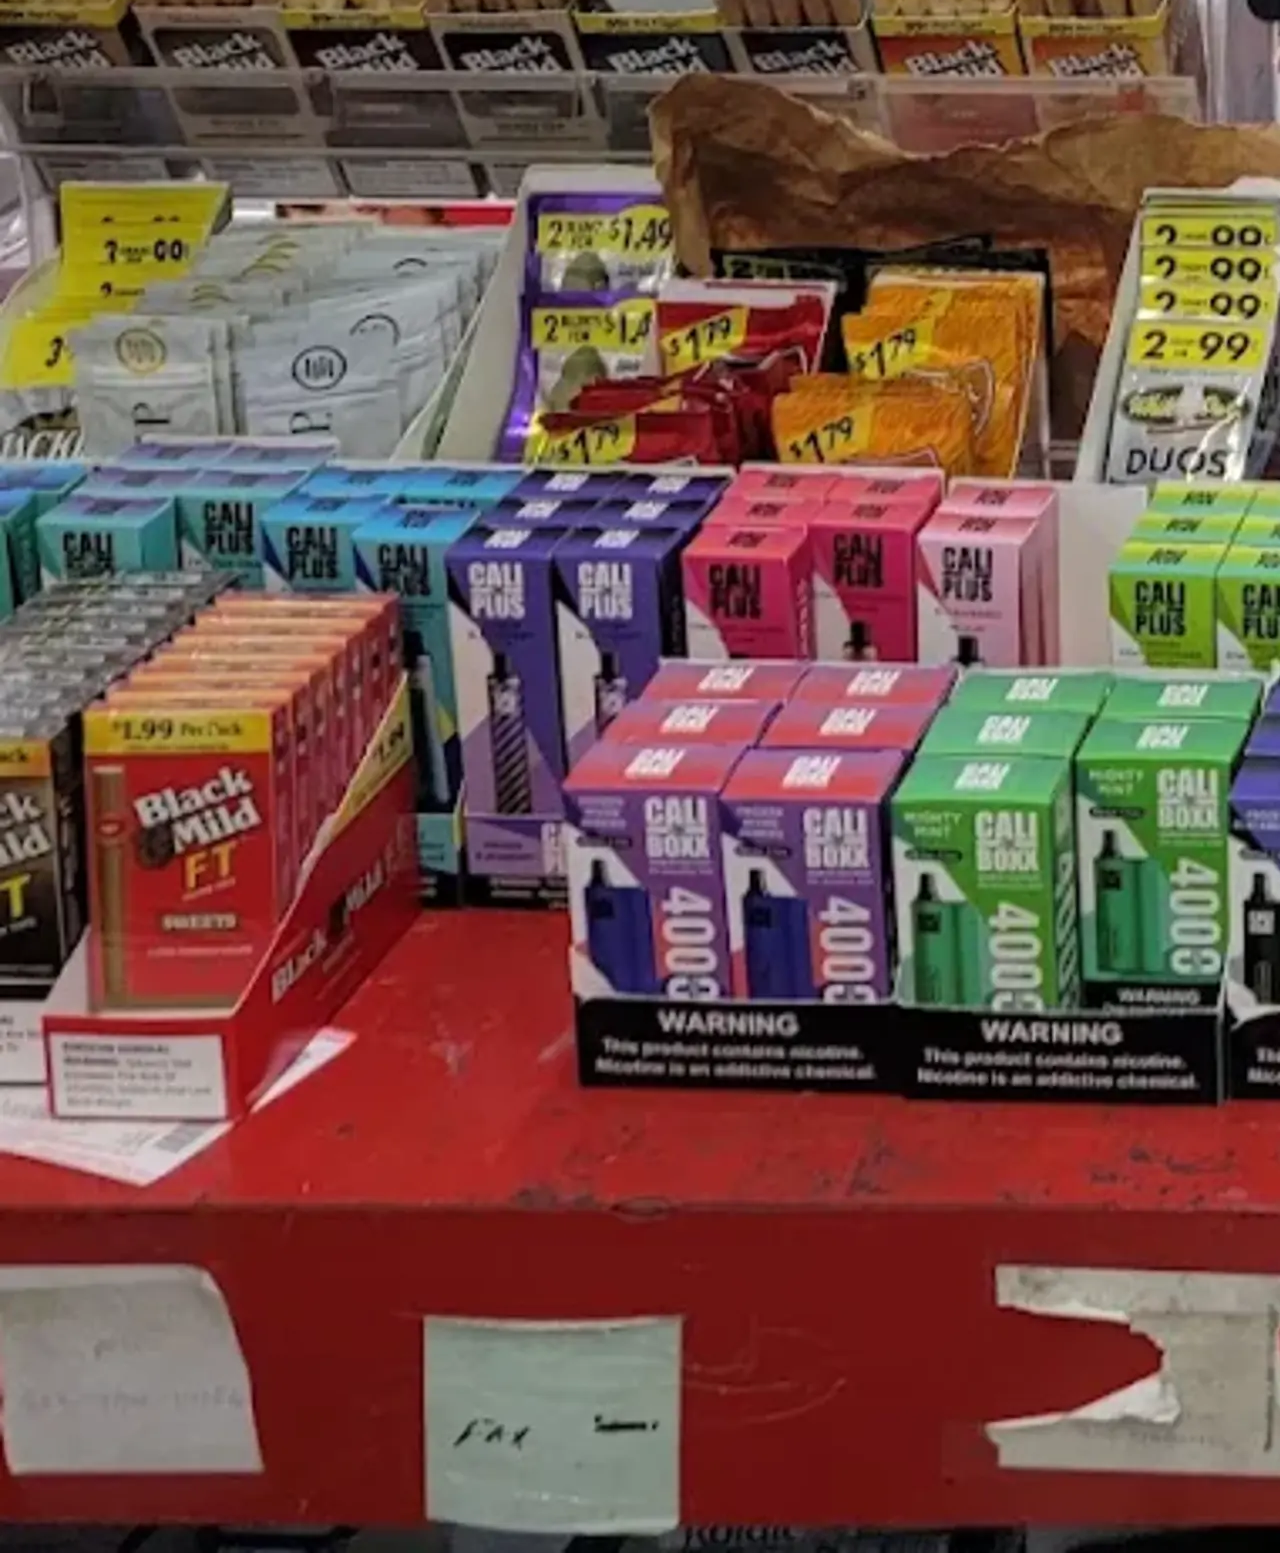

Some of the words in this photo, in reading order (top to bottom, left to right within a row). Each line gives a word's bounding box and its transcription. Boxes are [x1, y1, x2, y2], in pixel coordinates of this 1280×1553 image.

[547, 220, 562, 246] 2
[1127, 446, 1228, 477] DUOS
[204, 500, 254, 526] CALI
[205, 528, 256, 554] PLUS
[941, 548, 992, 575] CALI
[577, 562, 632, 589] CALI
[942, 576, 993, 601] PLUS
[579, 591, 634, 620] PLUS
[133, 767, 253, 828] Black
[645, 796, 706, 829] CALI
[169, 800, 262, 854] Mild
[646, 832, 710, 859] BOXX
[183, 843, 236, 894] FT
[658, 1009, 800, 1037] WARNING
[981, 1019, 1124, 1046] WARNING
[602, 1037, 638, 1055] This
[641, 1041, 709, 1061] product
[712, 1042, 786, 1059] contains
[790, 1042, 864, 1061] nicotine.
[595, 1059, 665, 1076] Nicotine
[668, 1060, 686, 1077] is
[689, 1062, 713, 1077] an
[715, 1060, 794, 1079] addictive
[795, 1062, 878, 1081] chemical.
